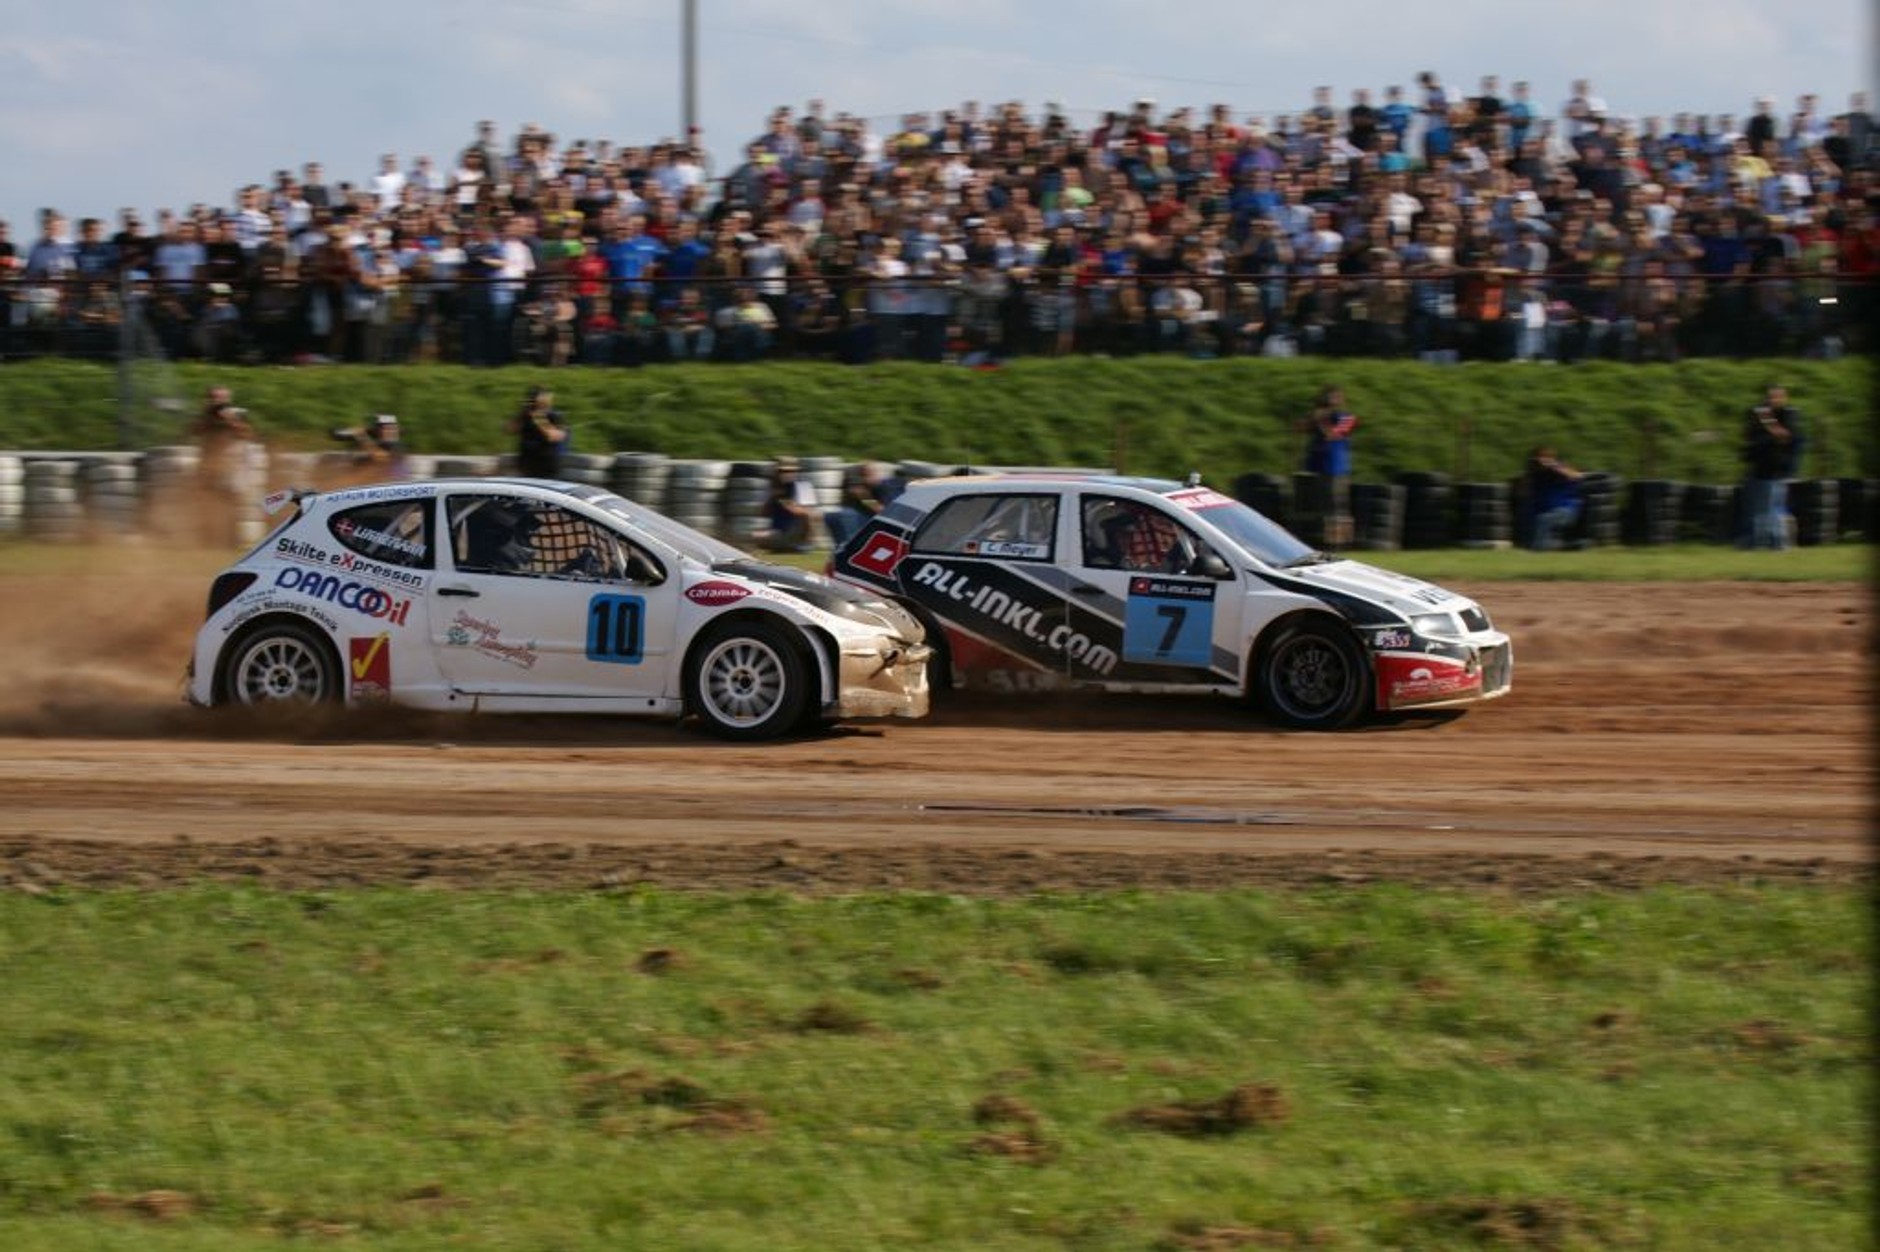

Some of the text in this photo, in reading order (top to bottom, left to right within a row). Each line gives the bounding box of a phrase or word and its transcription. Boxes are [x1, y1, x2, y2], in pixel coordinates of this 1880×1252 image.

[276, 537, 424, 587] Skilte eXpressen
[688, 588, 748, 599] caramba
[592, 600, 640, 656] 10
[1156, 605, 1187, 656] 7
